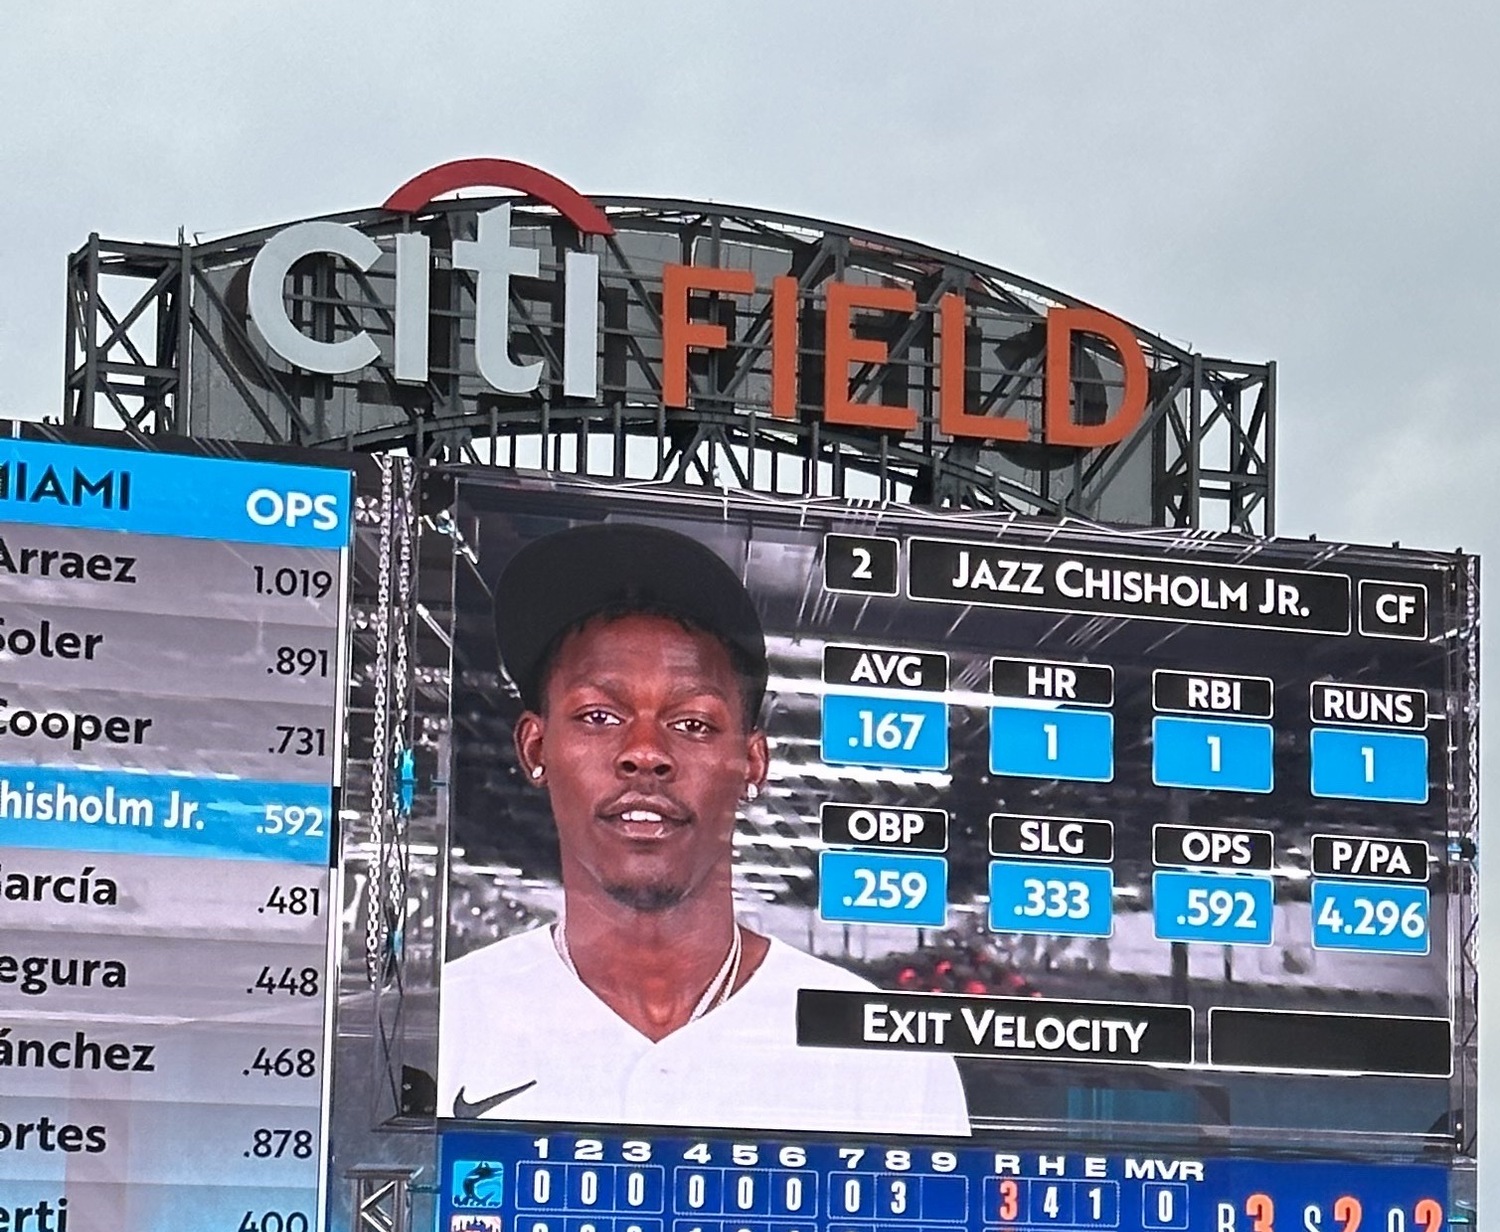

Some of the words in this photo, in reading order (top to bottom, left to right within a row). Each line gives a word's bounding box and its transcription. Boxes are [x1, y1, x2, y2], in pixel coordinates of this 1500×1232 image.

[247, 200, 600, 398] citi
[661, 263, 1148, 447] FIELD
[0, 461, 131, 511] IAMI
[246, 489, 338, 531] OPS
[853, 548, 872, 580] 2
[254, 566, 332, 597] 1.019
[1375, 592, 1416, 624] CF
[267, 647, 328, 677] .891
[852, 653, 922, 686] AVG
[1027, 667, 1076, 699] HR
[1187, 678, 1241, 711] RBI
[1323, 692, 1413, 724] RUNS
[268, 725, 325, 756] .731
[847, 712, 924, 750] .167
[1045, 725, 1058, 761] 1
[1208, 737, 1221, 772] 1
[1362, 749, 1375, 783] 1
[164, 790, 204, 830] Jr.
[256, 804, 323, 837] .592
[848, 811, 924, 844] OBP
[1019, 821, 1083, 854] SLG
[1181, 832, 1250, 865] OPS
[1332, 842, 1411, 876] P/PA
[258, 886, 319, 916] .481
[842, 870, 927, 909] .259
[1014, 880, 1090, 918] .333
[1176, 890, 1257, 929] .592
[1317, 900, 1425, 939] 4.296
[247, 966, 318, 996] .448
[863, 1005, 951, 1045] EXIT
[961, 1008, 1148, 1055] VELOCITY
[242, 1047, 315, 1078] .468
[243, 1128, 312, 1159] .878
[1126, 1160, 1204, 1181] MVR
